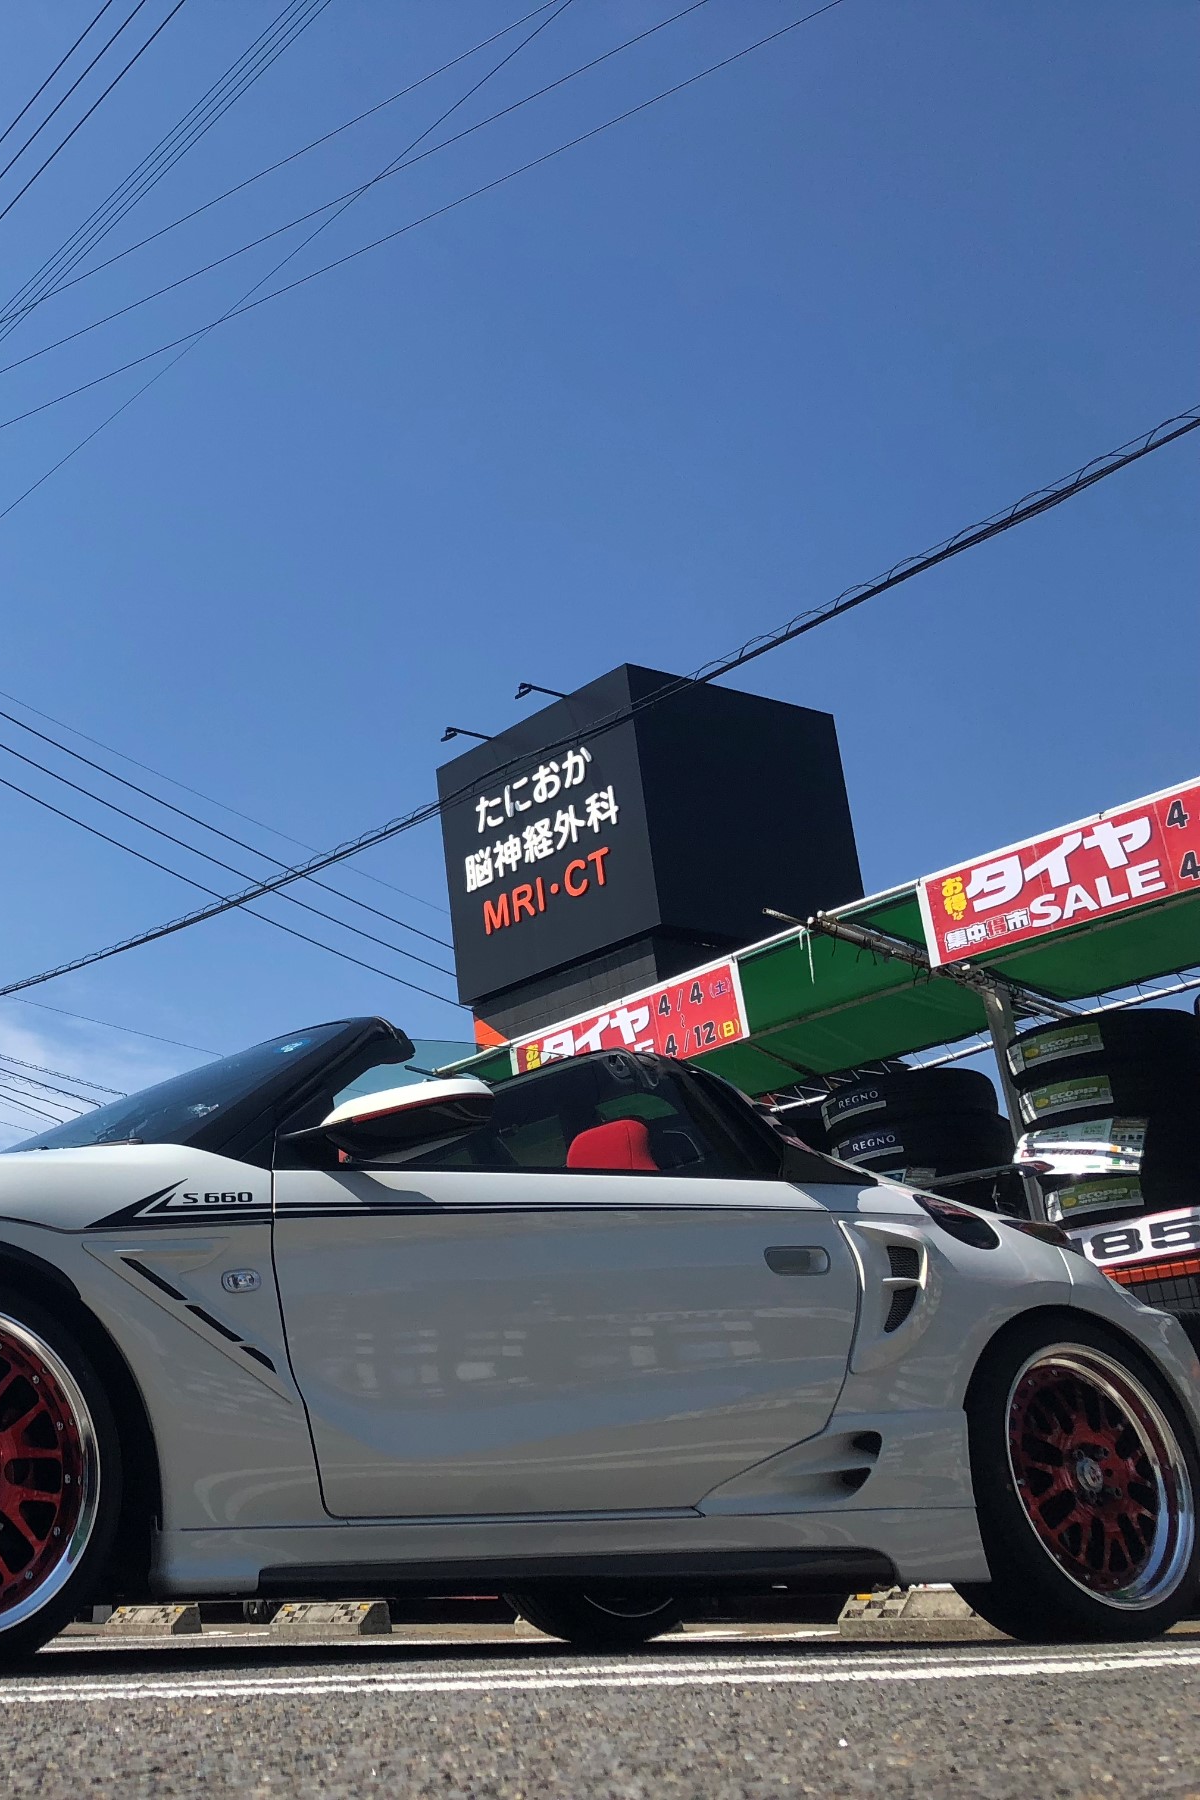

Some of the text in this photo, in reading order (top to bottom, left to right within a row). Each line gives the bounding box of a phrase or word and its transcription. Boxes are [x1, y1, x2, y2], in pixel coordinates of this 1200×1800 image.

[476, 747, 593, 834] たにおか
[465, 785, 620, 893] 脳神経外科
[965, 816, 1152, 913] タイヤ
[1029, 859, 1167, 928] SALE
[945, 907, 1030, 952] 集中得市
[838, 1090, 879, 1109] REGNO
[852, 1134, 896, 1152] REGNO
